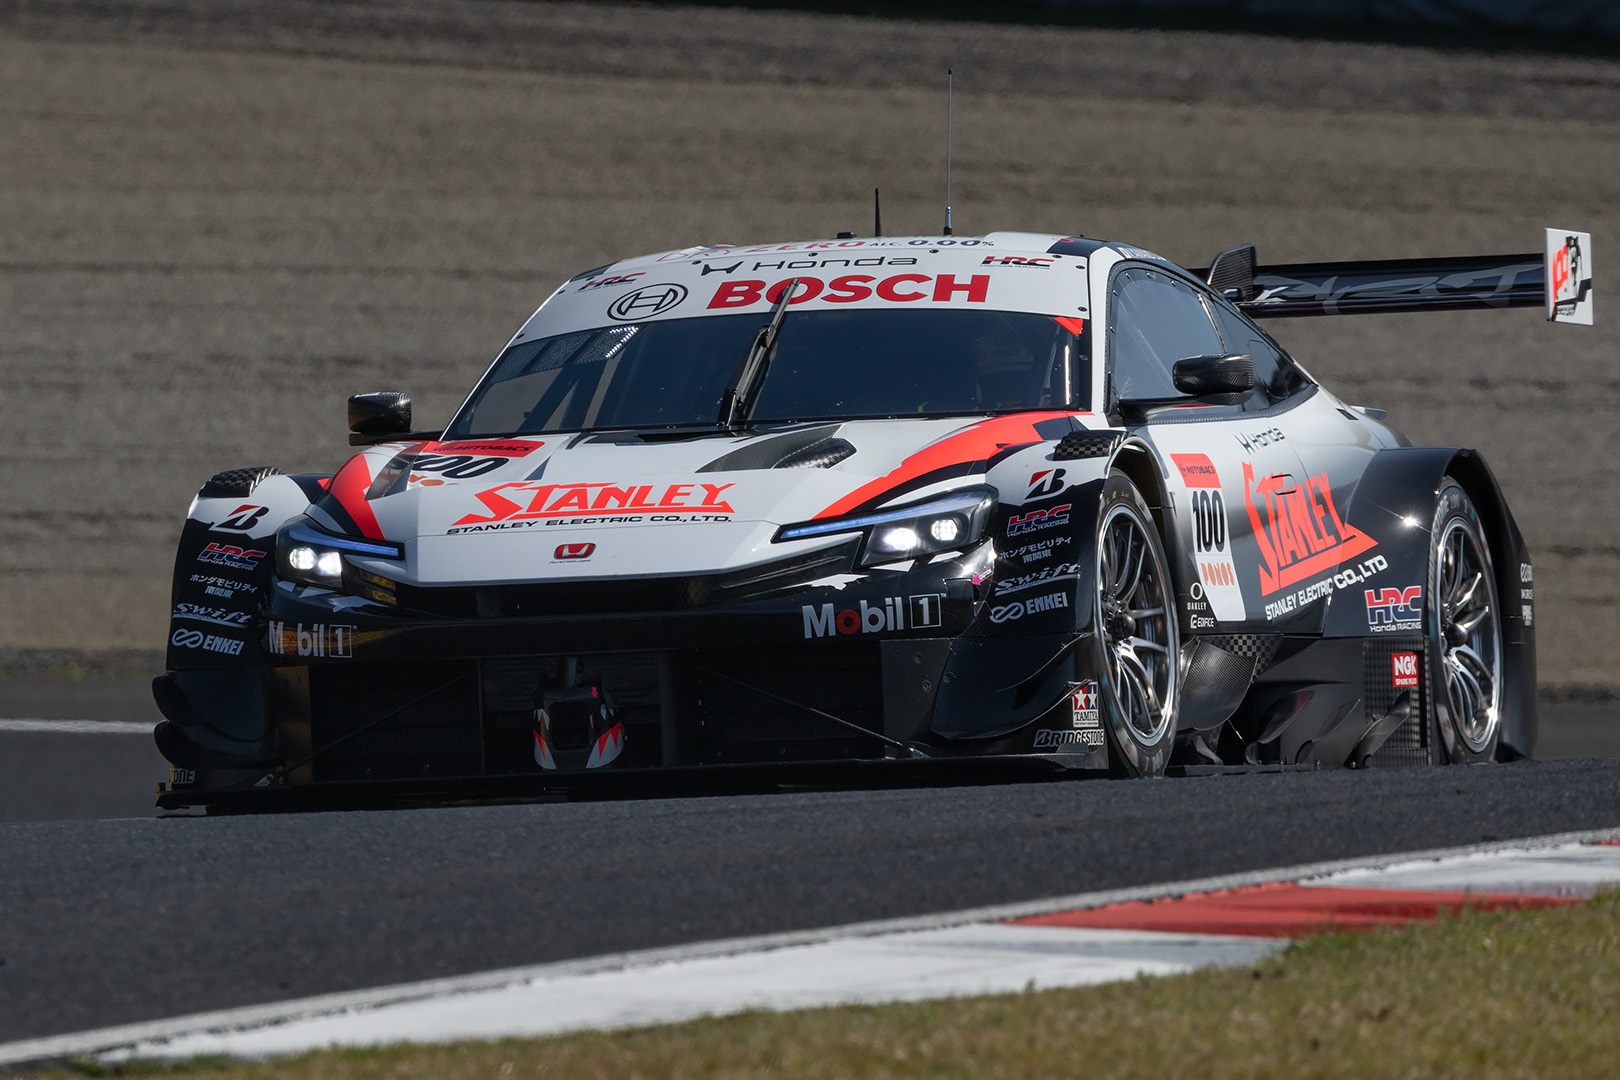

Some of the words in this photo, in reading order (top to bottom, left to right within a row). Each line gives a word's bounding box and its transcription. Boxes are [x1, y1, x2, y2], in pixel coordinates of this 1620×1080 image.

[752, 256, 918, 272] Honda
[981, 255, 1055, 267] HRC
[706, 273, 991, 309] BOSCH
[1186, 465, 1216, 475] AUTOBACS
[451, 481, 736, 526] STANLEY
[446, 521, 538, 535] STANLEY
[546, 516, 643, 526] ELECTRIC
[1006, 503, 1072, 534] HRC
[1192, 489, 1226, 552] 100
[1241, 461, 1379, 597] STANLEY
[199, 542, 267, 567] HRC
[1000, 536, 1072, 559] ホンダモビリティ
[190, 574, 258, 593] ホンダモビリティ
[1200, 562, 1235, 586] PONOS
[1025, 591, 1069, 615] ENKEI
[1187, 602, 1207, 610] OAKLEY
[1265, 593, 1297, 621] STANLEY
[1298, 577, 1334, 605] ELECTRIC
[1364, 585, 1422, 625] HRC
[802, 596, 904, 639] Mobil
[1369, 624, 1397, 633] Honda
[1397, 622, 1422, 631] RACING
[202, 634, 245, 656] ENKEI
[268, 620, 325, 658] Mobil
[1394, 655, 1417, 676] NGK
[1033, 729, 1104, 747] BRIDGESTONE
